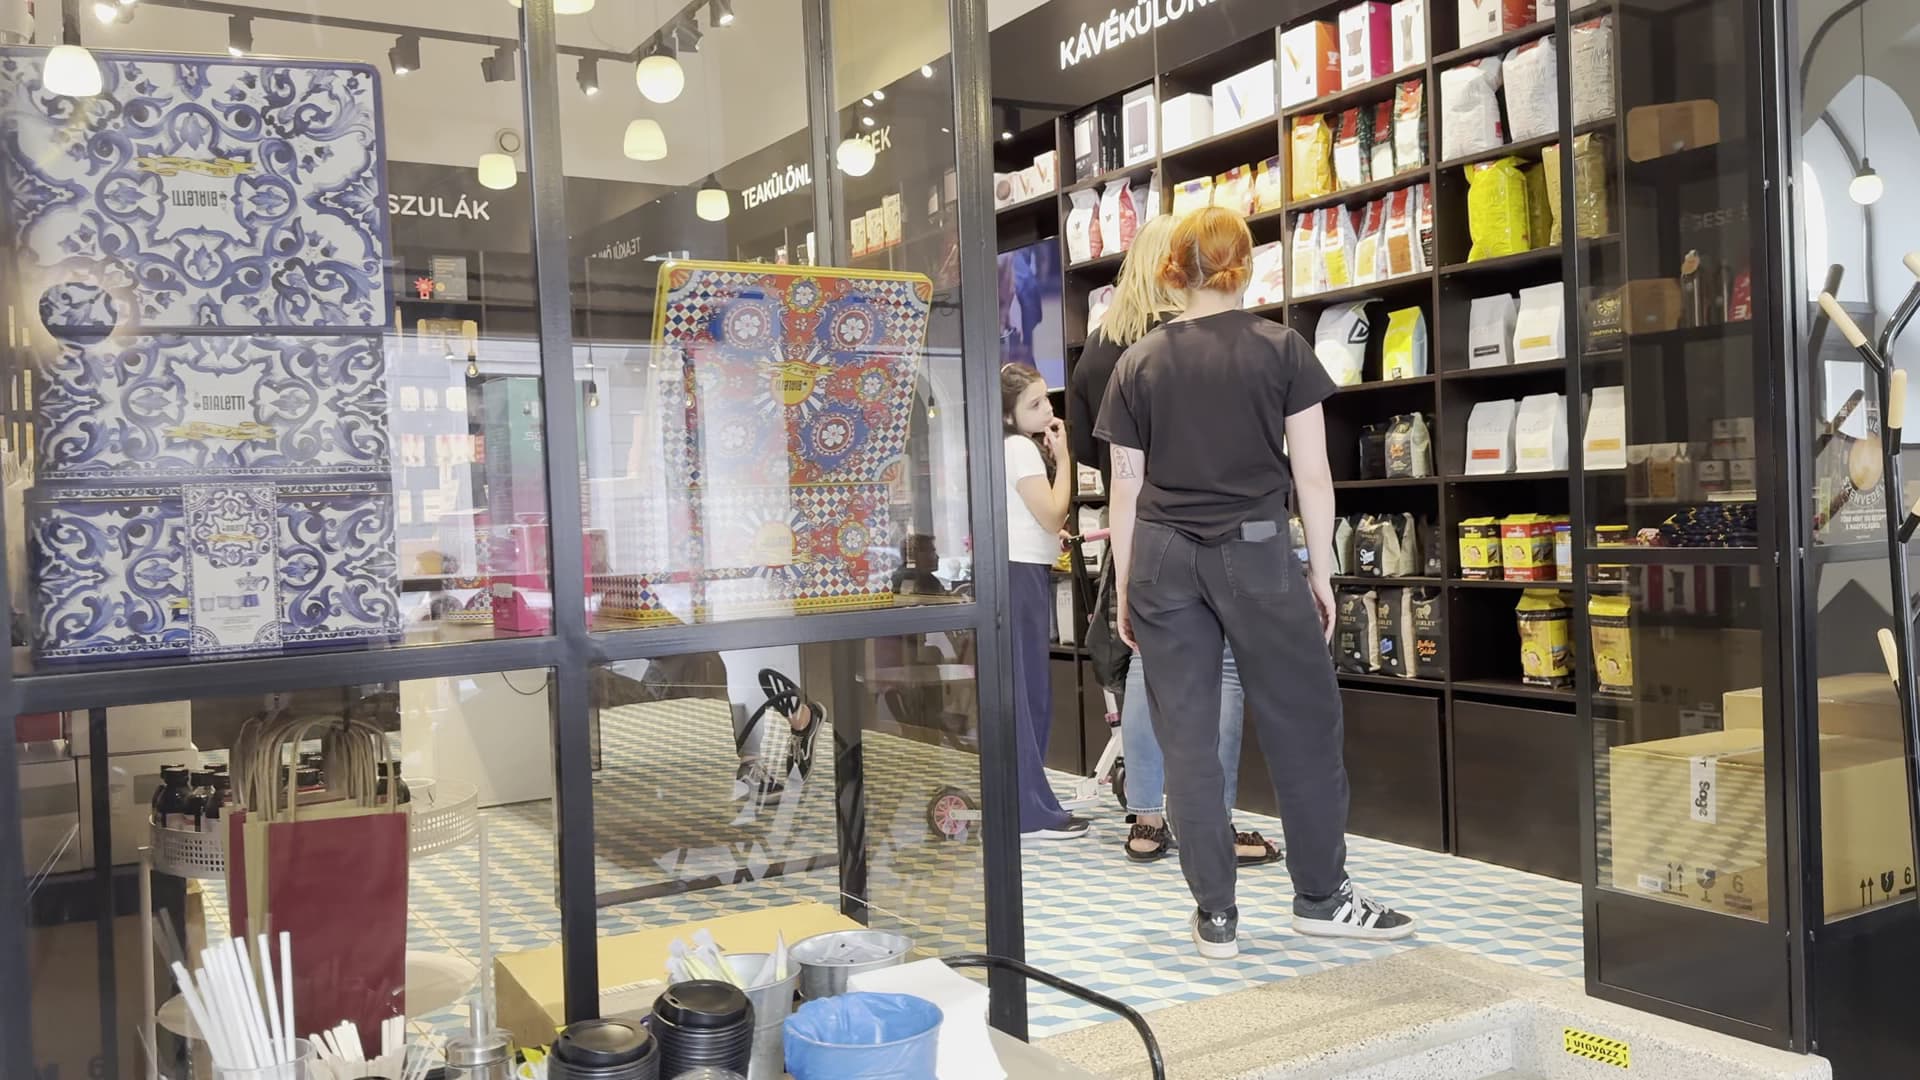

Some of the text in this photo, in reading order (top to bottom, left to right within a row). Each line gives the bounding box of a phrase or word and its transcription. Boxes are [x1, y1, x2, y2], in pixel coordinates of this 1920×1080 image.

[202, 395, 246, 411] BIALETTI
[1695, 780, 1711, 817] Sage
[1732, 875, 1744, 893] 6
[1904, 866, 1911, 885] 6
